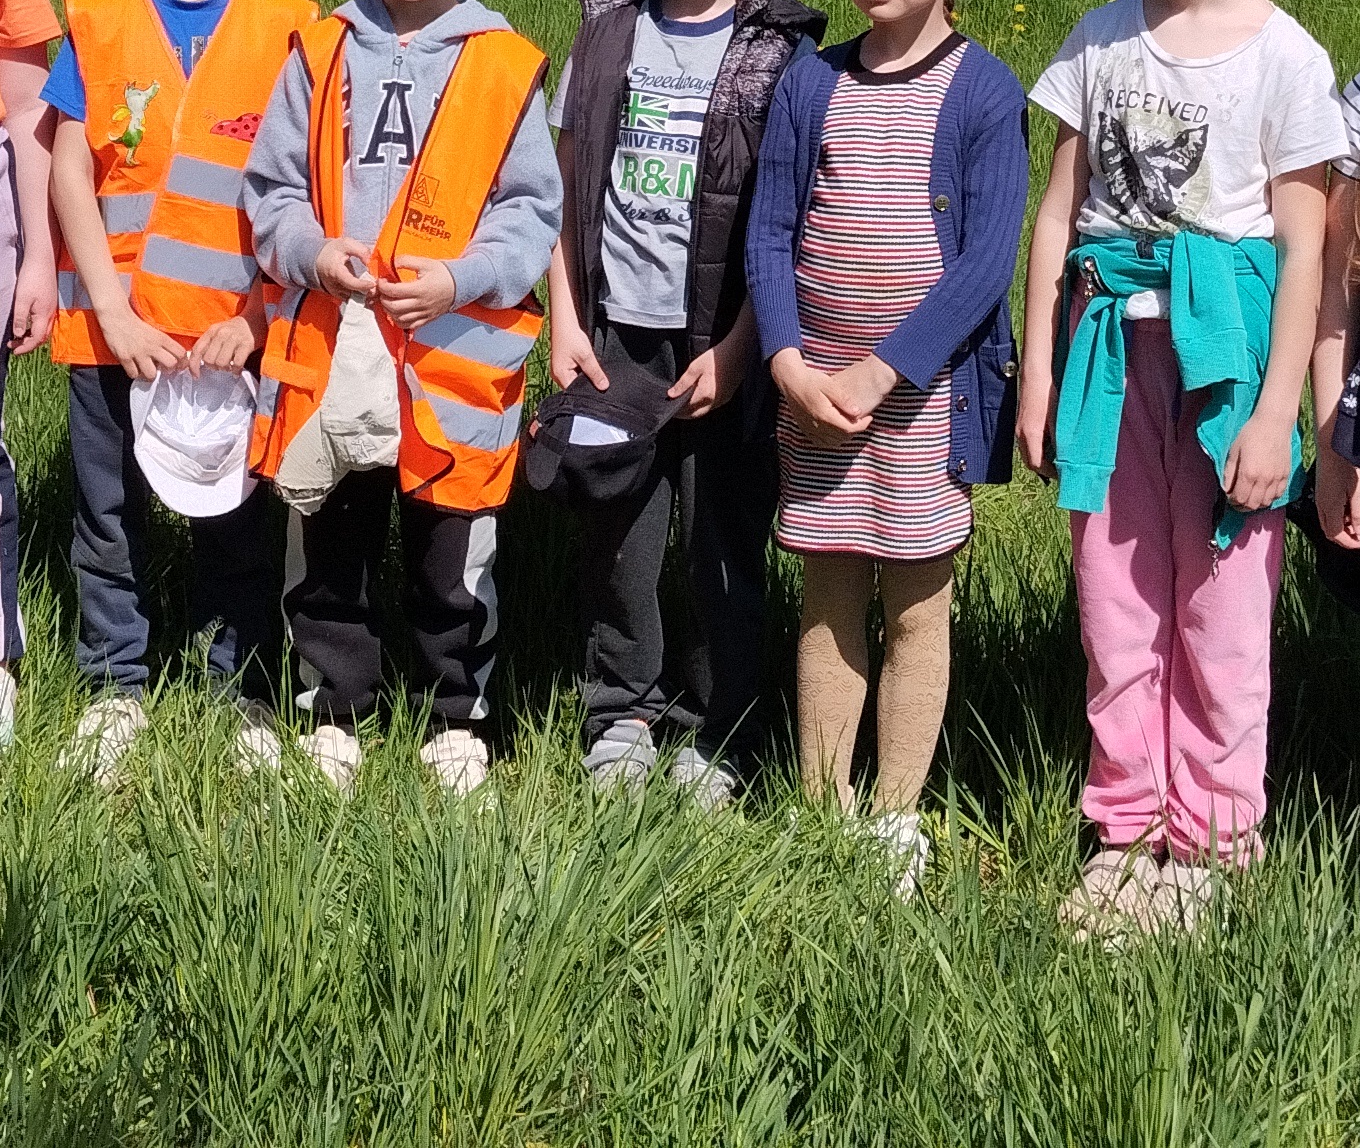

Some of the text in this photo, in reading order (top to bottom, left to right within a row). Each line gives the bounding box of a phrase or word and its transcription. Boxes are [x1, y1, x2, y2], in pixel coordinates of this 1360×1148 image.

[1106, 89, 1209, 123] RECEIVED
[423, 214, 446, 228] FÜR
[420, 222, 452, 241] MEHR
